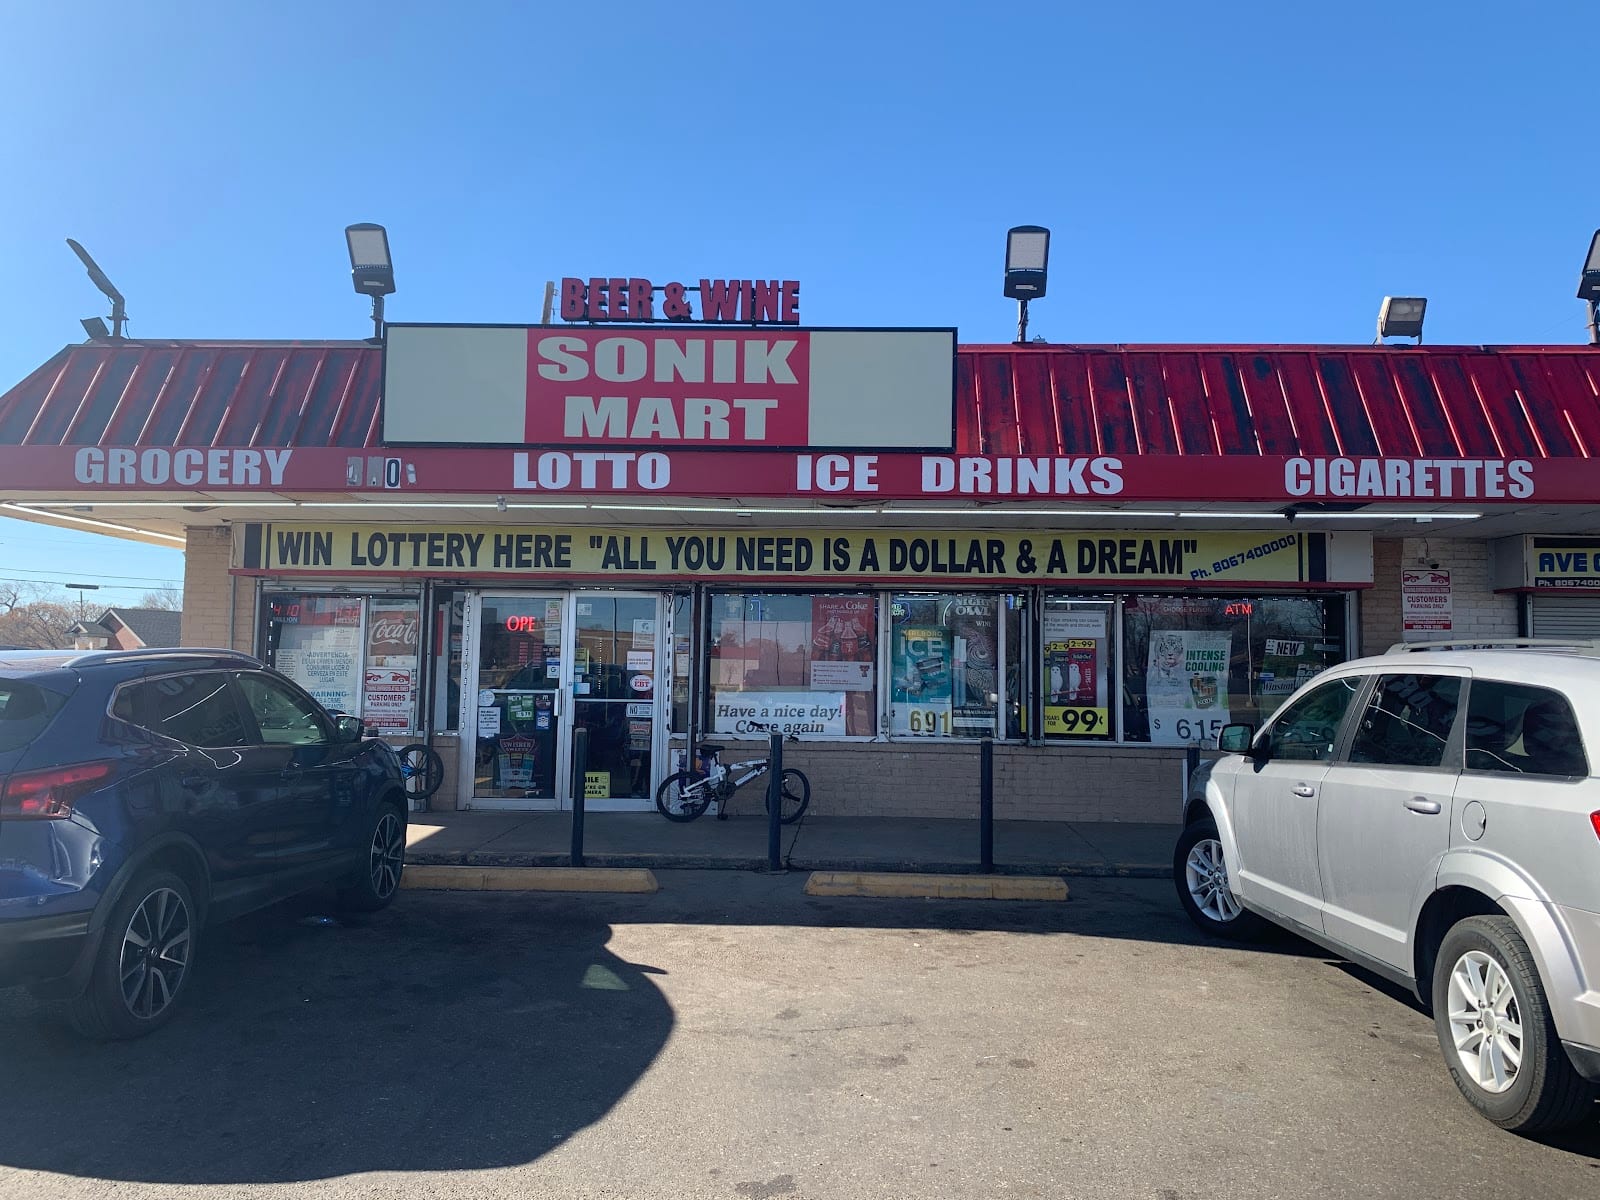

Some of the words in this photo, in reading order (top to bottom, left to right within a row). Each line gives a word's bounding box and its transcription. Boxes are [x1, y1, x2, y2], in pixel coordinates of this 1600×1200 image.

[561, 278, 654, 322] BEER
[663, 282, 692, 321] &
[699, 279, 801, 322] WINE
[537, 336, 799, 385] SONIK
[563, 396, 779, 441] MART
[75, 447, 294, 486] GROCERY
[513, 451, 671, 490] LOTTO
[797, 454, 879, 492] ICE
[921, 456, 1124, 495] DRINKS
[1284, 457, 1535, 499] CIGARETTES
[277, 531, 333, 566] WIN
[351, 532, 485, 567] LOTTERY
[494, 533, 572, 568] HERE
[589, 535, 657, 570] "ALL
[665, 536, 726, 571] YOU
[735, 537, 813, 572] NEED
[823, 539, 851, 572] IS
[860, 539, 881, 573] A
[889, 538, 1006, 573] DOLLAR
[1016, 540, 1037, 573] &
[1046, 540, 1068, 574] A
[1077, 539, 1198, 575] DREAM"
[1539, 553, 1588, 573] AVE
[846, 601, 868, 610] Coke
[1407, 595, 1448, 603] CUSTOMERS
[955, 605, 991, 616] OWL
[1224, 603, 1253, 615] ATM
[901, 637, 944, 657] ICE
[1185, 650, 1226, 661] INTENSE
[1275, 642, 1299, 656] NEW
[1184, 661, 1225, 672] COOLING
[716, 705, 757, 718] Have
[761, 707, 769, 718] a
[774, 705, 808, 718] nice
[813, 704, 843, 721] day!
[783, 719, 825, 735] again
[1153, 718, 1161, 730] $
